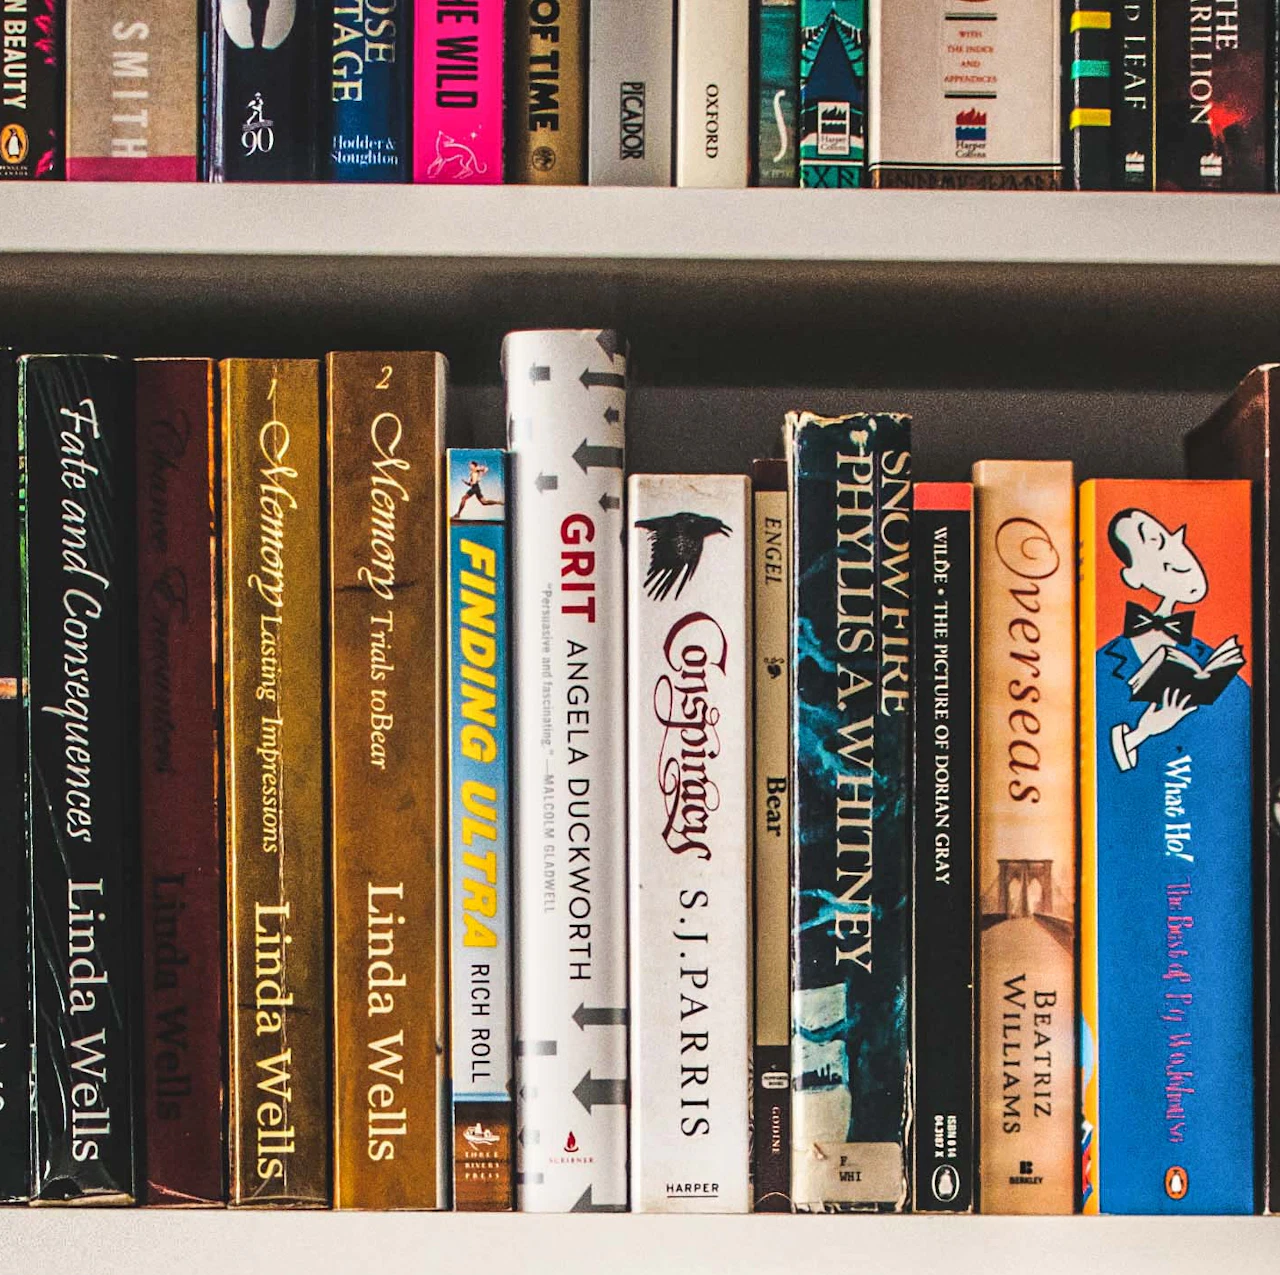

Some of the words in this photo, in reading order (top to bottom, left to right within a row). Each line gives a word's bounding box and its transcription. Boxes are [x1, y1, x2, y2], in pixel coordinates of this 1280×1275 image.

[3, 20, 27, 109] BEAUTY
[112, 21, 148, 158] SMITH
[435, 36, 478, 109] WILD
[529, 50, 559, 132] TIME
[1123, 36, 1146, 109] LEAF
[241, 129, 274, 157] 90
[333, 135, 377, 151] Hodder
[621, 82, 644, 160] PICADOR
[705, 84, 719, 159] OXFORD
[330, 150, 400, 166] Stoughton
[559, 512, 597, 624] GRIT
[763, 515, 784, 587] ENGEL
[933, 526, 950, 583] WILDE
[933, 601, 950, 637] THE
[565, 639, 595, 765] ANGELA
[933, 643, 950, 719] PICTURE
[934, 726, 950, 751] OF
[764, 776, 786, 838] Bear
[934, 755, 951, 827] DORIAN
[565, 777, 594, 982] DUCKWORTH
[933, 834, 951, 886] GRAY
[770, 1105, 782, 1155] GODINE
[665, 1182, 720, 1192] HARPER
